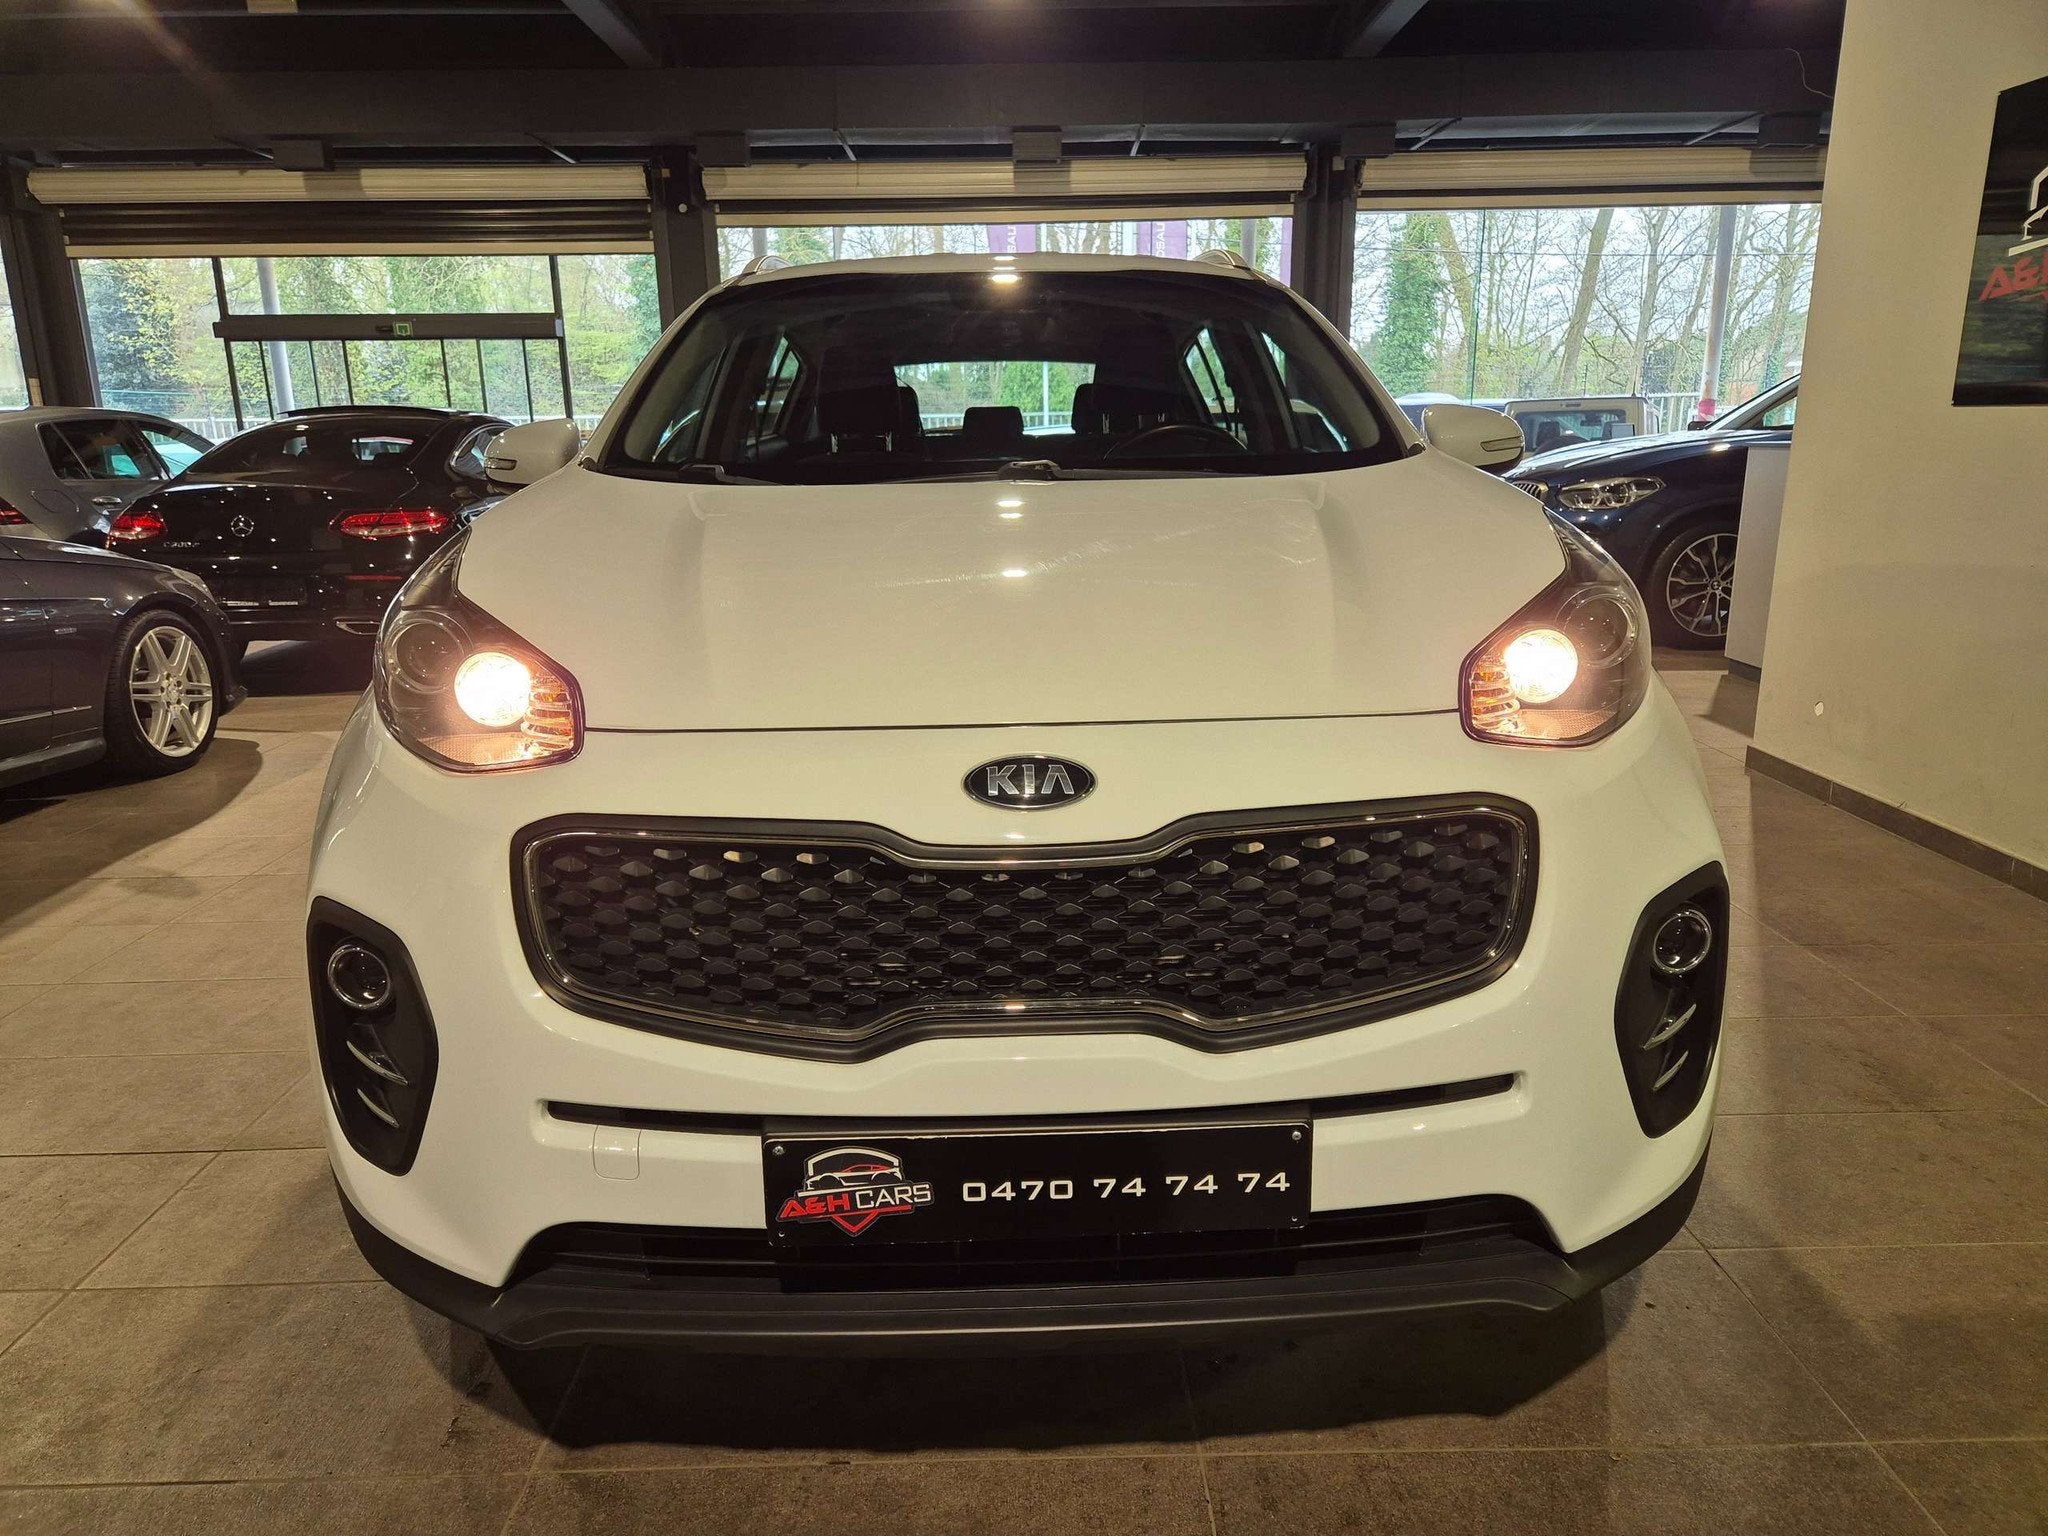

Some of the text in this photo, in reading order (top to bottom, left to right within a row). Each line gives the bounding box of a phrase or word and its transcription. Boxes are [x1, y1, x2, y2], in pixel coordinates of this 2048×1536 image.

[1979, 251, 2048, 302] A&
[986, 764, 1075, 796] KIA
[779, 1183, 932, 1219] A&H CARS
[962, 1171, 1291, 1202] 0470 74 74 74
